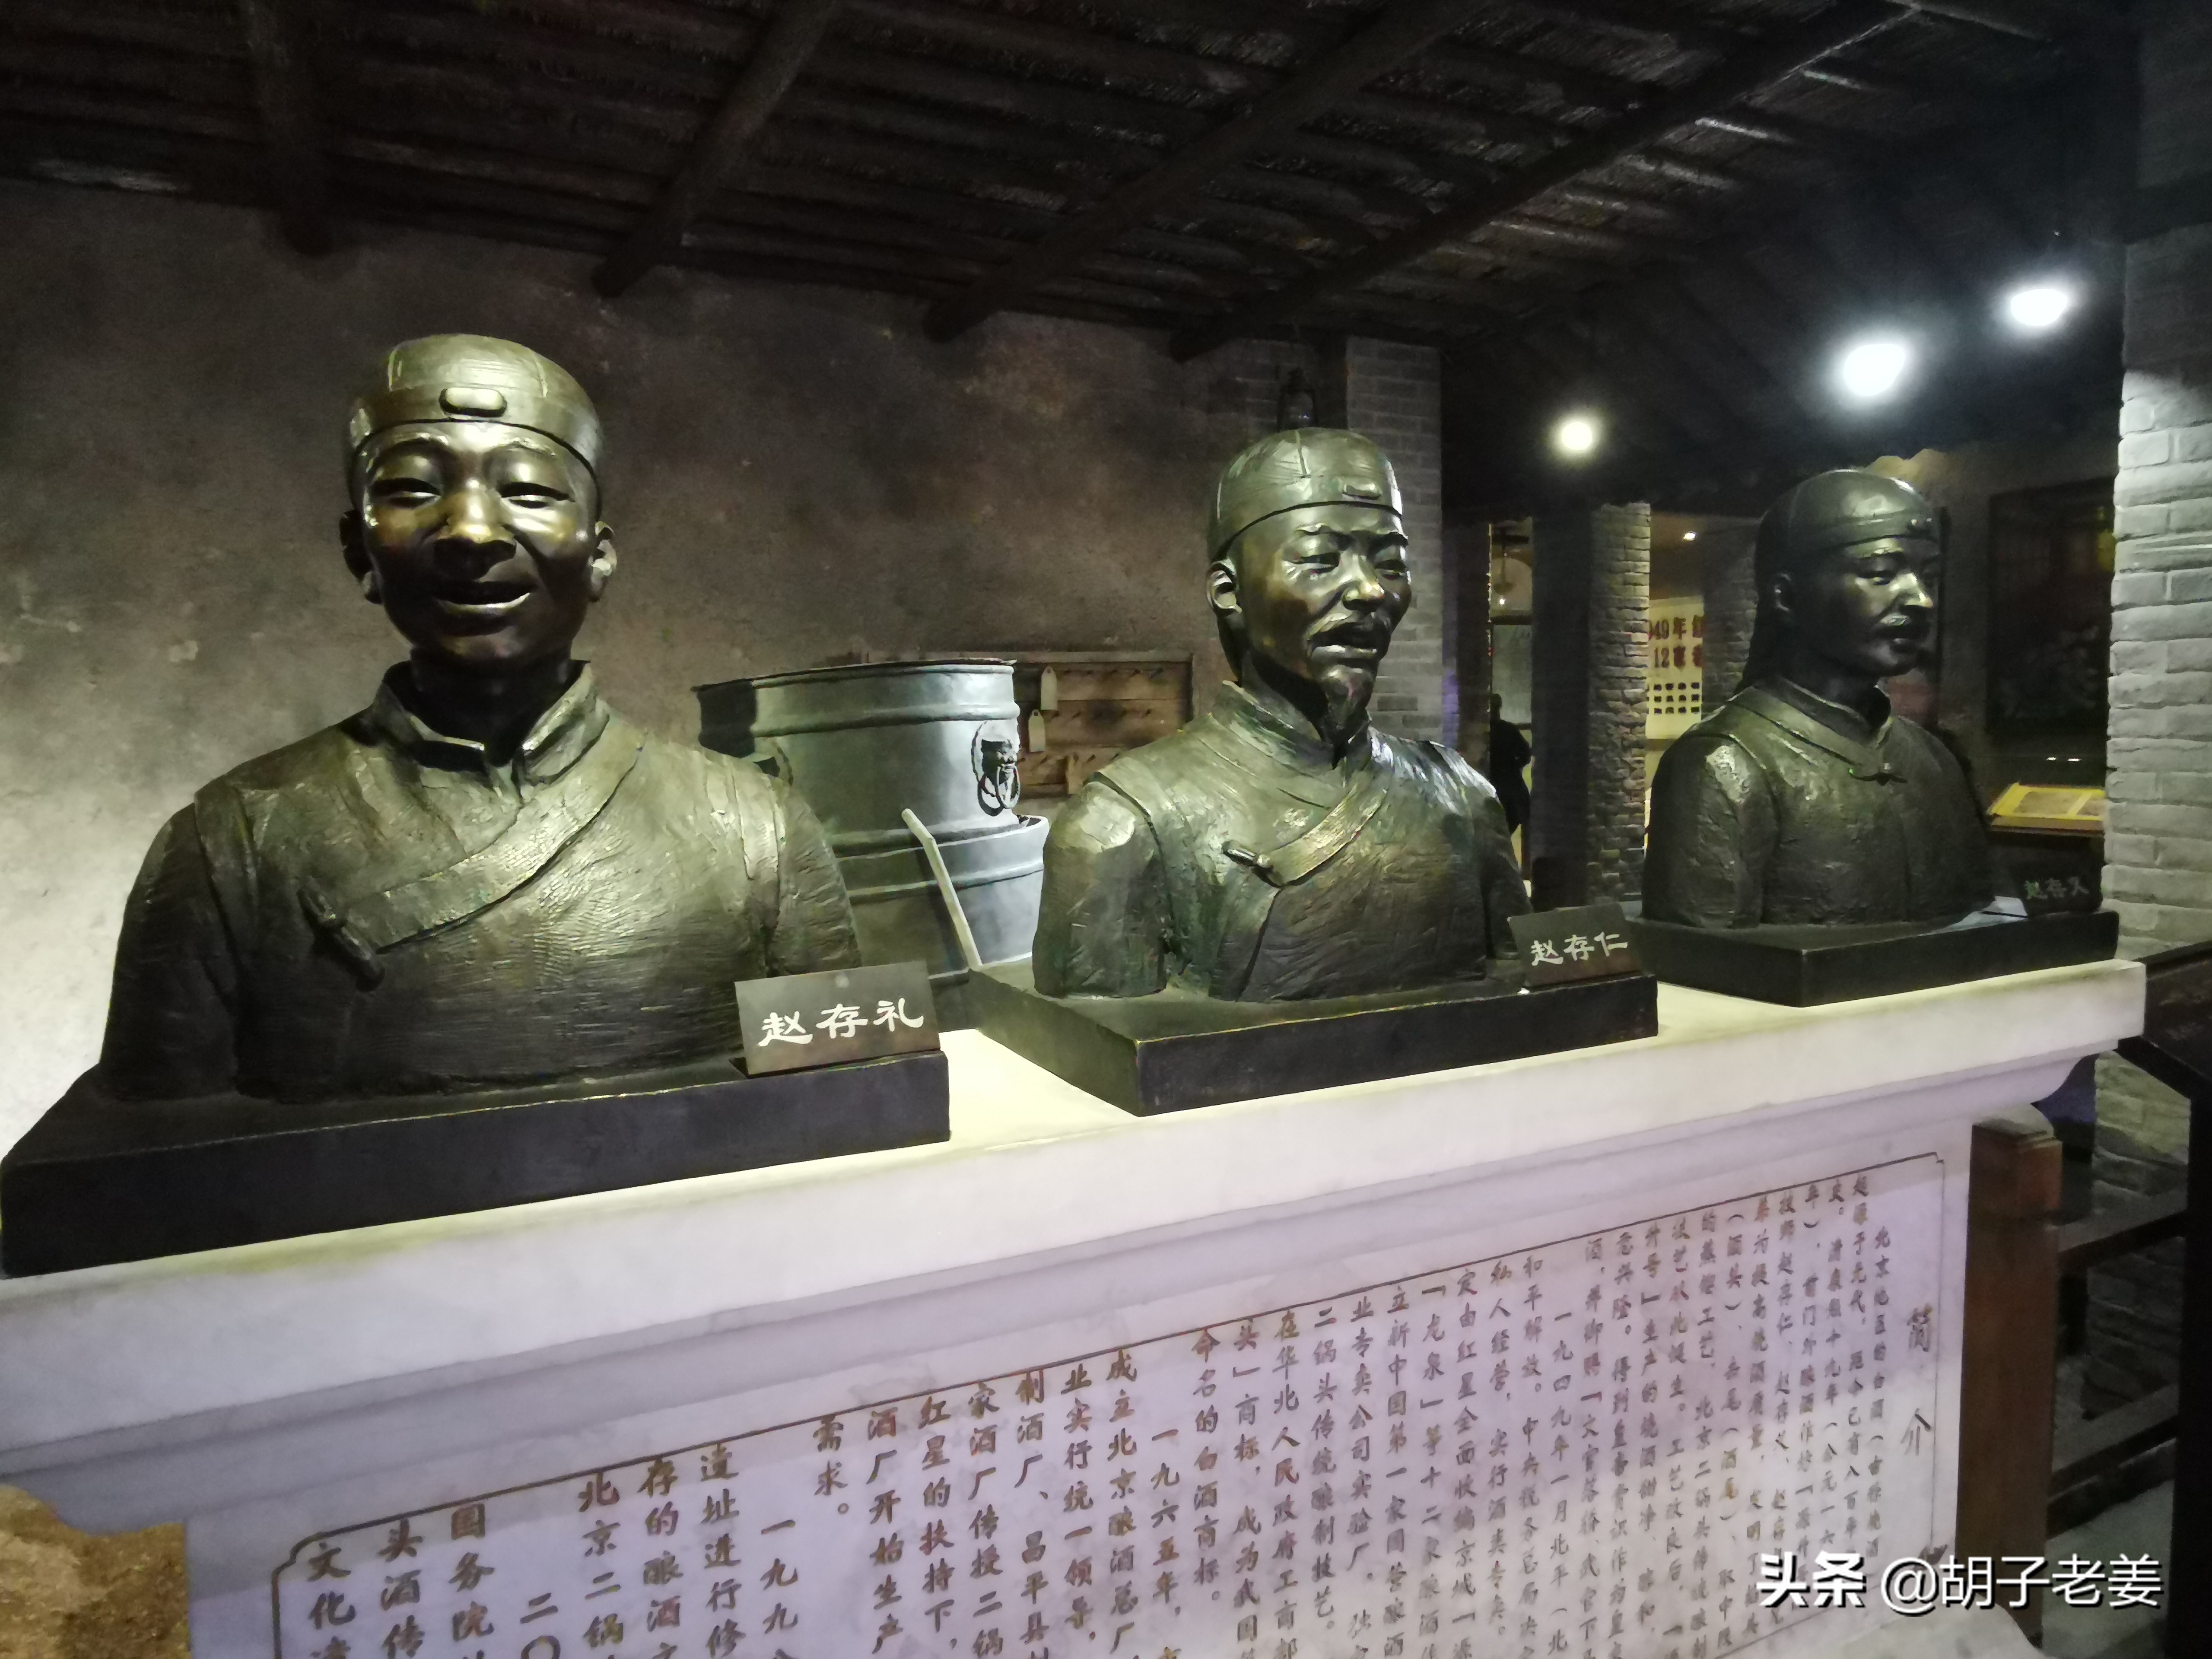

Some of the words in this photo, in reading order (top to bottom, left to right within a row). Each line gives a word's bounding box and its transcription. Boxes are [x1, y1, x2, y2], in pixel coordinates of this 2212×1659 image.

[758, 998, 924, 1046] 赵存礼
[1531, 931, 1628, 966] 赵存仁
[449, 1503, 495, 1659] 国务院
[578, 1470, 623, 1659] 北京二锅
[866, 1407, 904, 1654] 酒厂开始生产
[1106, 1349, 1139, 1659] 成立北京酿酒总厂
[760, 1519, 798, 1659] 一九九
